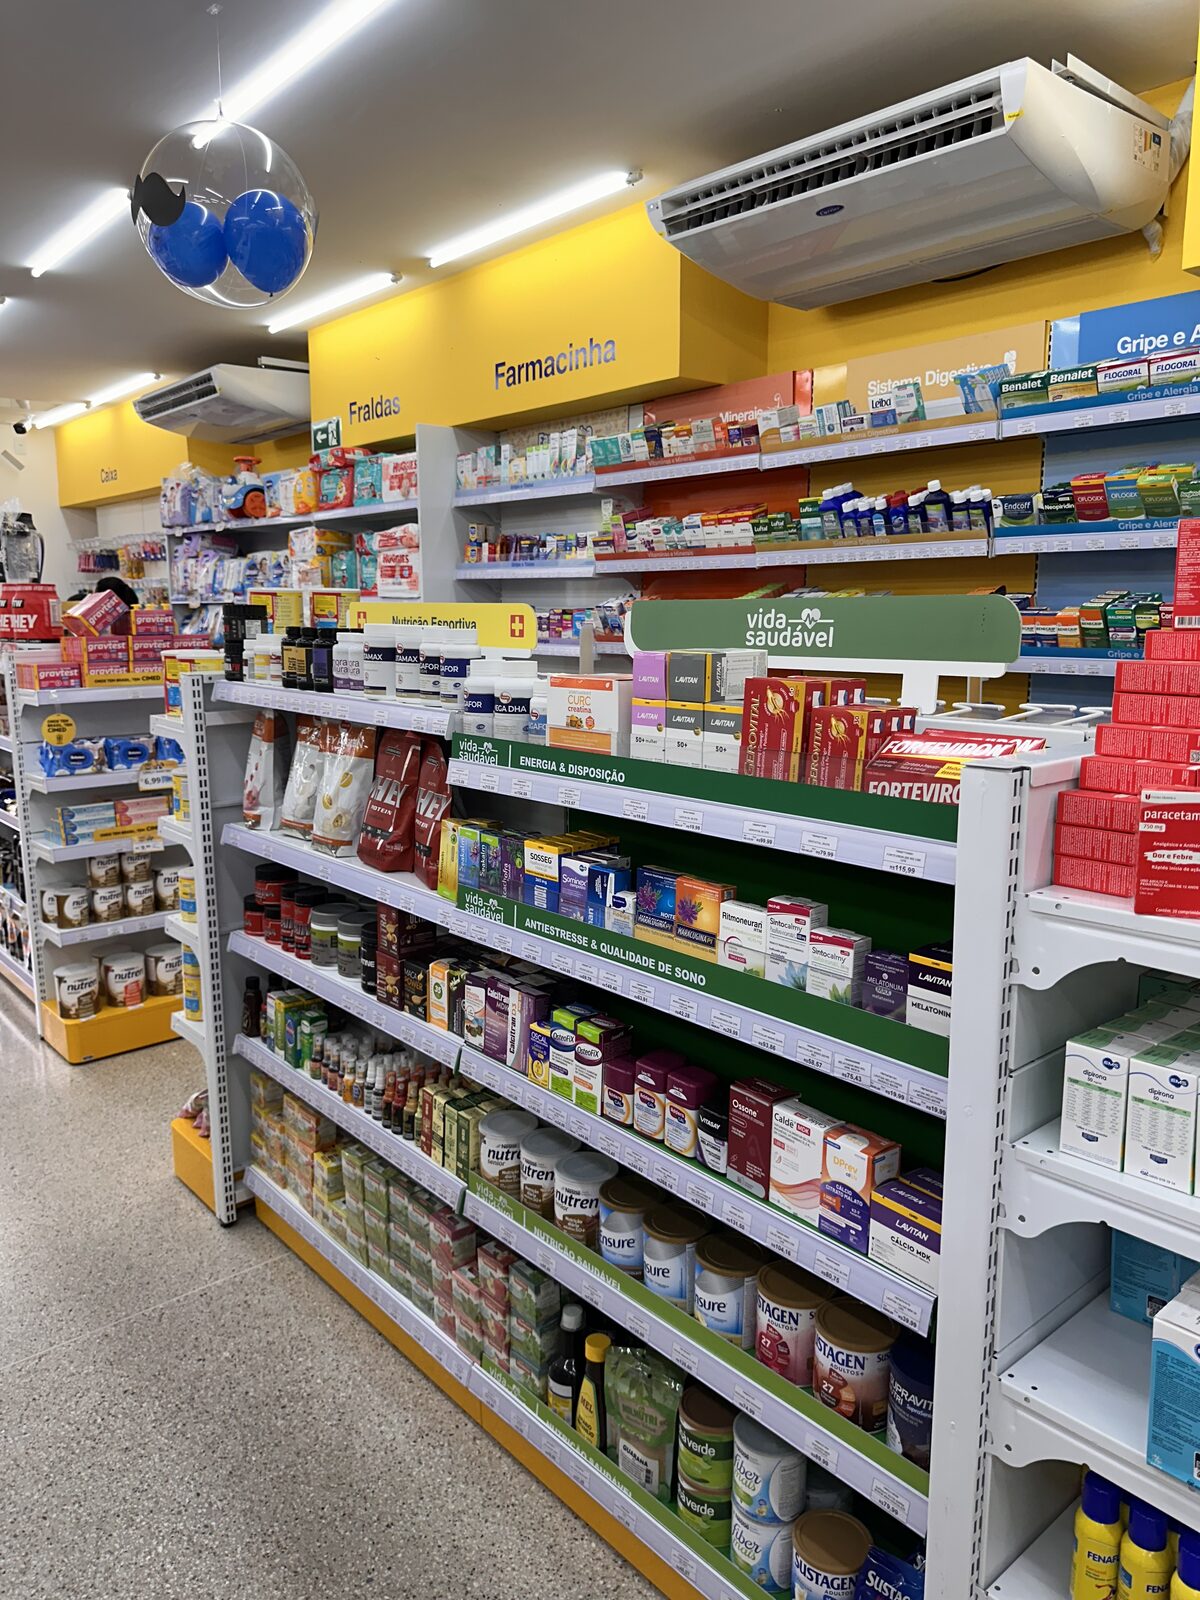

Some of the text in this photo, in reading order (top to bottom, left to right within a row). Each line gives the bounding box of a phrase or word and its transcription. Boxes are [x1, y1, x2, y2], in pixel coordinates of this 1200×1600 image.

[1117, 331, 1168, 354] Gripe
[1173, 331, 1185, 344] e
[495, 338, 617, 390] Farmacinha
[1156, 359, 1197, 372] FLOGORAL
[1050, 369, 1093, 383] Benalet
[1104, 368, 1142, 380] FLOGORAL
[867, 375, 921, 396] Sistema
[1002, 380, 1042, 392] Benalet
[1127, 391, 1153, 402] Gripe
[1163, 385, 1198, 396] Alergia
[349, 394, 401, 425] Fraldas
[101, 468, 117, 484] Caixa
[1004, 502, 1030, 511] Endcoff
[1119, 522, 1143, 531] Gripe
[89, 597, 119, 625] gravtest
[136, 615, 173, 625] gravtest
[431, 616, 477, 630] Esportiva
[746, 608, 787, 629] vida
[746, 624, 834, 648] saudável
[88, 641, 126, 652] gravtest
[133, 641, 171, 651] gravtest
[174, 640, 209, 649] gravtest
[1108, 650, 1129, 659] Gripe
[39, 669, 79, 680] gravtest
[675, 676, 698, 684] LAVITAN
[568, 695, 591, 706] CURC
[508, 705, 526, 713] DHA
[637, 712, 658, 720] LAVITAN
[672, 715, 695, 724] LAVITAN
[711, 719, 735, 728] LAVITAN
[744, 694, 760, 776] GEROVITAL
[459, 739, 478, 752] vida
[881, 740, 1015, 758] FORTEVIRON
[459, 751, 498, 765] saudável
[519, 756, 625, 783] ENERGIA & DISPOSIÇÃO
[530, 852, 552, 865] SOSSEG
[890, 865, 915, 874] R$115,99
[562, 874, 587, 887] Sominex
[465, 892, 484, 906] vida
[465, 903, 504, 924] saudável
[722, 911, 763, 929] Ritmoneuran
[770, 917, 802, 934] Sintocalmy
[677, 927, 707, 943] MARACUGINA
[525, 918, 706, 986] ANTIESTRESSE & QUALIDADE DE SONO
[812, 947, 847, 964] Sintocalmy
[114, 968, 143, 980] nutren
[918, 972, 952, 988] LAVITAN
[867, 976, 903, 992] MELATONUM
[912, 1001, 951, 1018] MELATONIN
[531, 1031, 547, 1043] OSCAL
[1103, 1059, 1121, 1070] EMS
[1082, 1069, 1107, 1082] dipirona
[1170, 1078, 1189, 1086] EMS
[1148, 1087, 1175, 1100] dipirona
[732, 1099, 758, 1118] Ossone
[700, 1114, 720, 1130] VITASAY
[833, 1156, 858, 1174] DPrev
[836, 1183, 853, 1196] CÁLCIO
[555, 1190, 599, 1209] nutren
[895, 1219, 929, 1241] LAVITAN
[891, 1235, 931, 1262] CÁLCIO MDK
[761, 1335, 770, 1348] 27
[822, 1380, 834, 1393] 27
[580, 1395, 594, 1414] MEL
[734, 1452, 762, 1485] fiber
[732, 1520, 762, 1554] fiber
